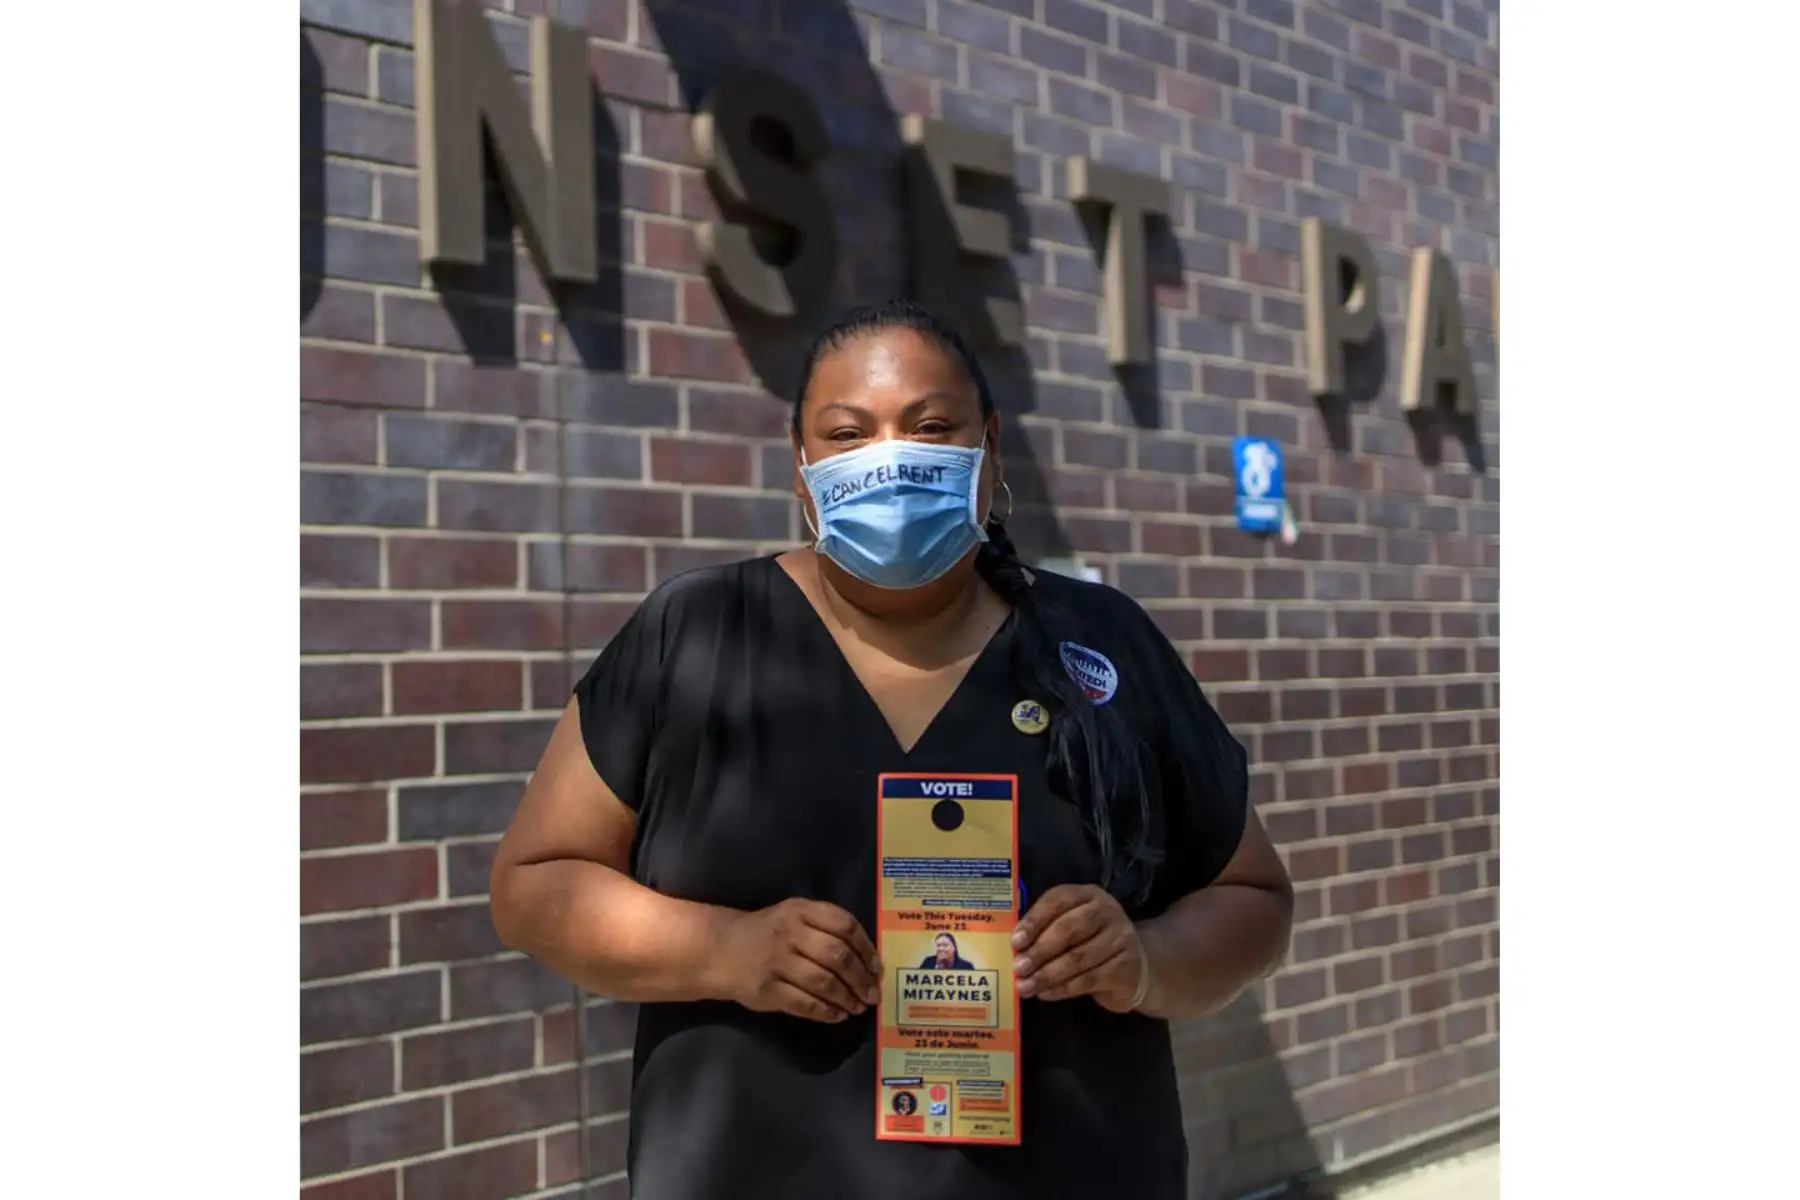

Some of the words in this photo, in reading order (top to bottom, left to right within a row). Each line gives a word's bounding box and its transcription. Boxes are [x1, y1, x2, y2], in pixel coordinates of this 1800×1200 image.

[1303, 216, 1499, 412] PA
[920, 781, 973, 796] VOTE!
[898, 911, 922, 921] Vote
[925, 911, 946, 921] This
[924, 922, 952, 931] June
[905, 973, 989, 987] MARCELA
[903, 988, 992, 1002] MITAYNES
[898, 1028, 922, 1038] Vote
[926, 1029, 949, 1038] este
[914, 1039, 928, 1048] 23
[930, 1039, 943, 1048] de
